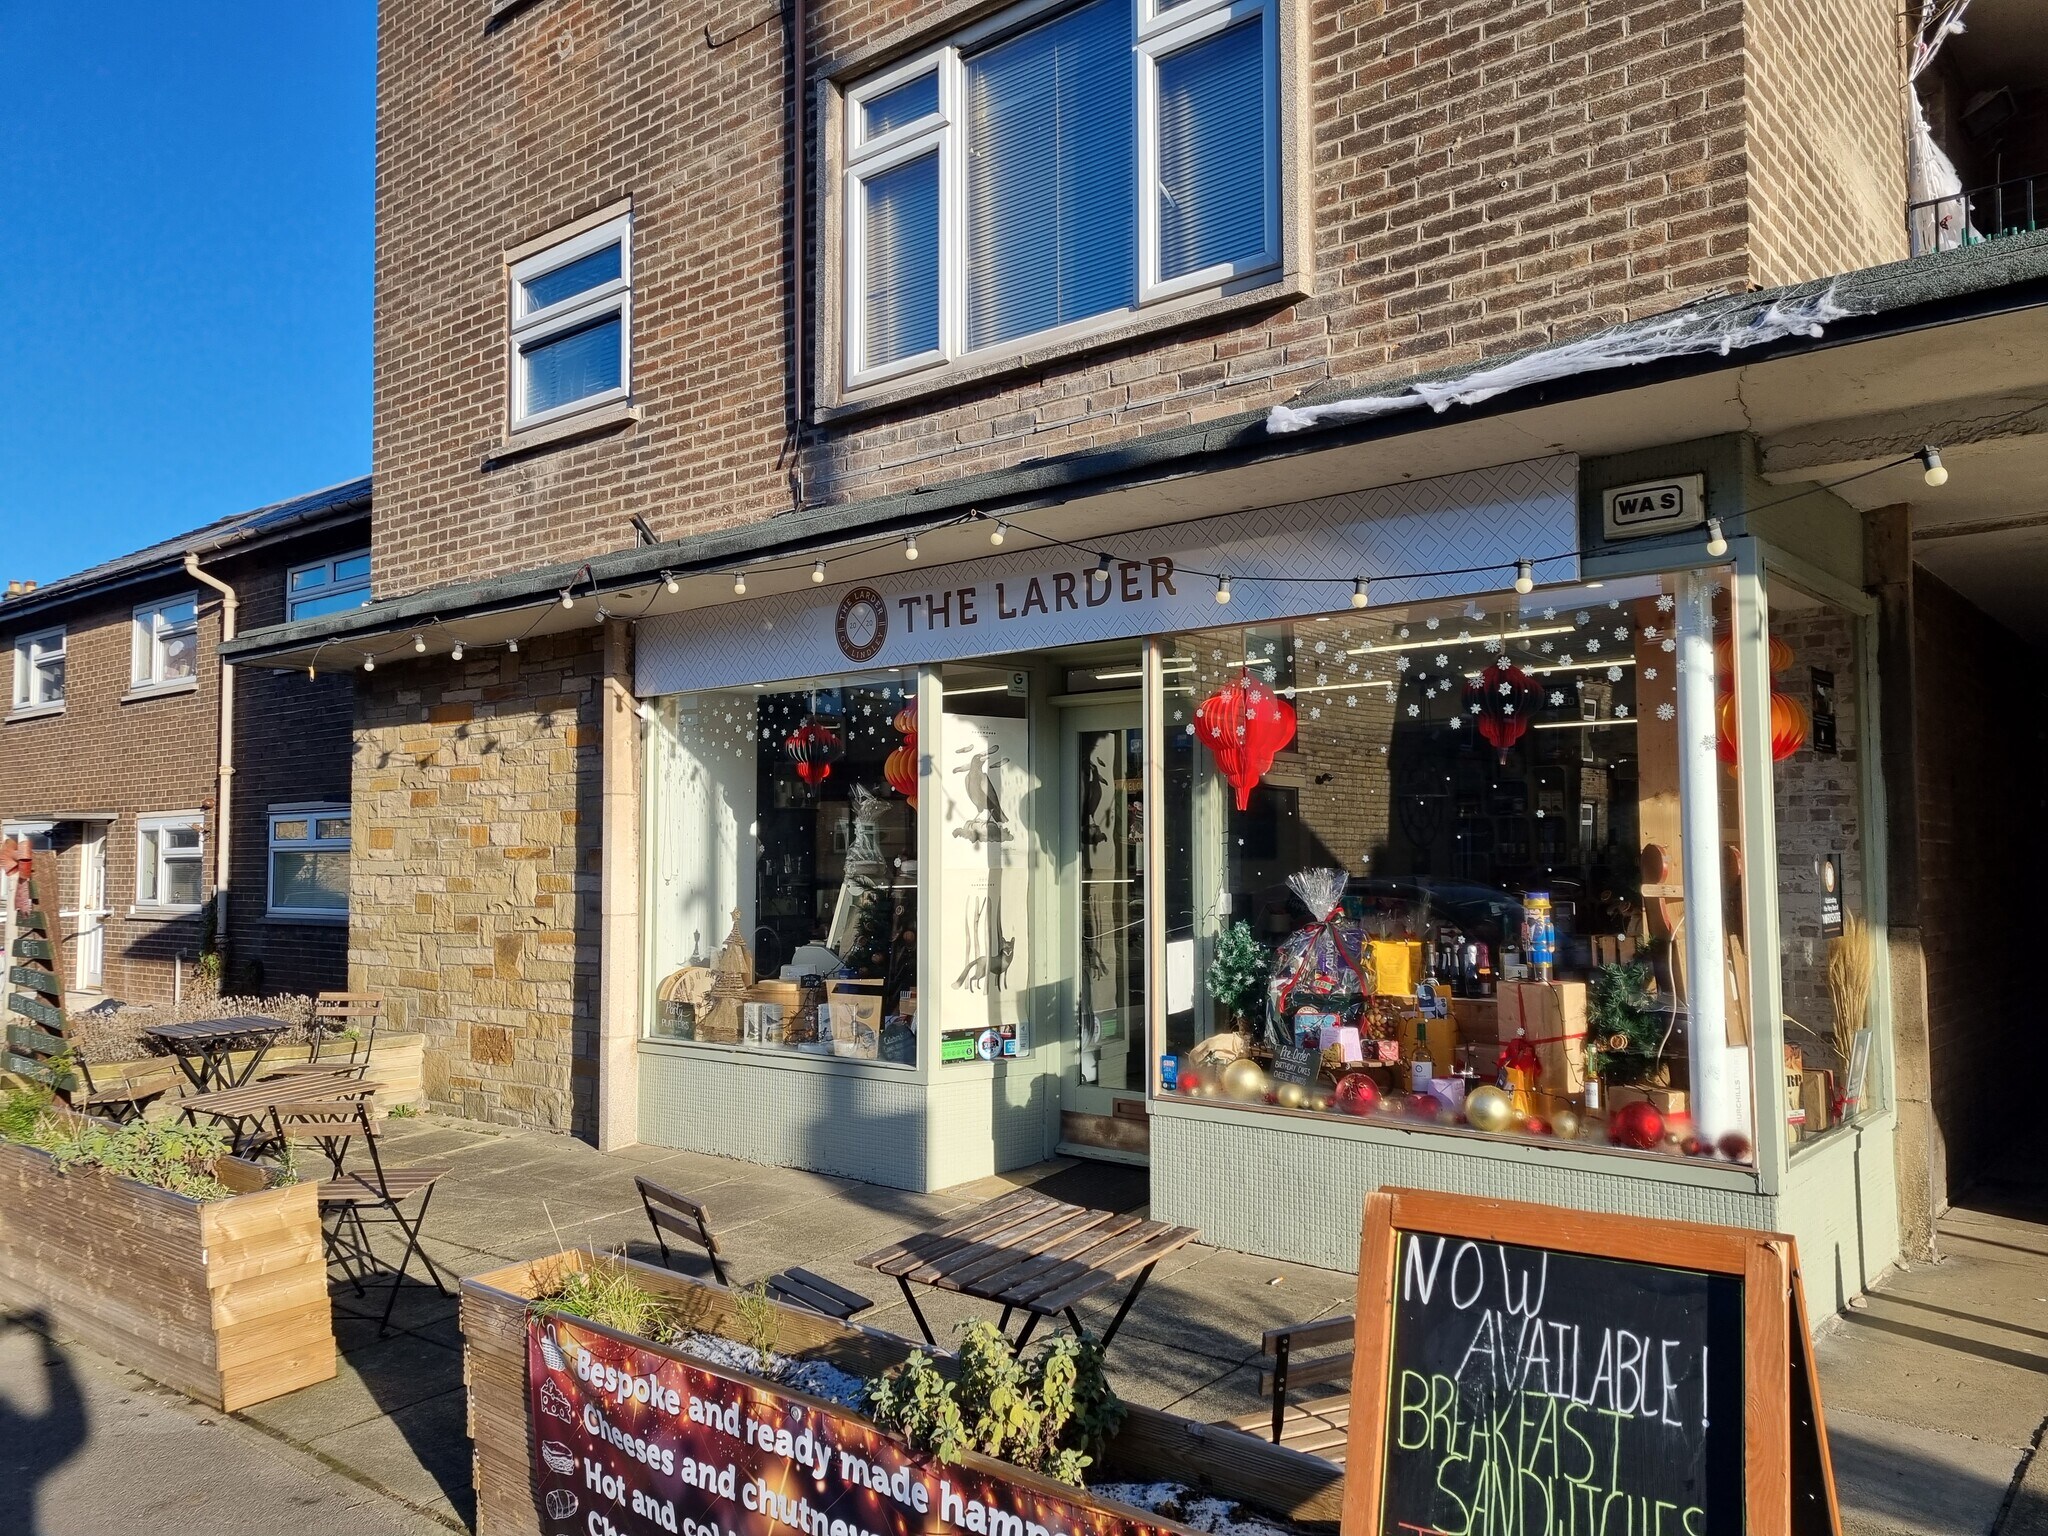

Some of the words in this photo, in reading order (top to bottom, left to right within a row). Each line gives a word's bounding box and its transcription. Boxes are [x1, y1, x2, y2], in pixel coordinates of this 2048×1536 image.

[1617, 492, 1676, 516] WAS
[839, 598, 853, 621] THE
[853, 590, 884, 615] LARDER
[898, 587, 978, 634] THE
[995, 555, 1177, 620] LARDER
[840, 635, 850, 650] ON
[851, 632, 883, 659] LINDLEY
[1325, 939, 1335, 970] DAIRY
[661, 1018, 690, 1031] PLATTERS
[665, 1000, 691, 1020] Party
[1274, 1060, 1297, 1072] BIRTHDAY
[1297, 1065, 1311, 1077] CAKES
[1280, 1045, 1310, 1062] Pre-Order
[1273, 1070, 1290, 1081] CHEESE
[1404, 1235, 1547, 1318] NOW
[576, 1347, 681, 1416] Bespoke
[688, 1395, 741, 1438] and
[746, 1416, 832, 1481] ready
[840, 1450, 929, 1514] made
[1397, 1369, 1635, 1492] BREAKFAST
[583, 1402, 675, 1476] Cheeses
[681, 1456, 736, 1502] and
[583, 1457, 626, 1507] Hot
[632, 1488, 678, 1535] and
